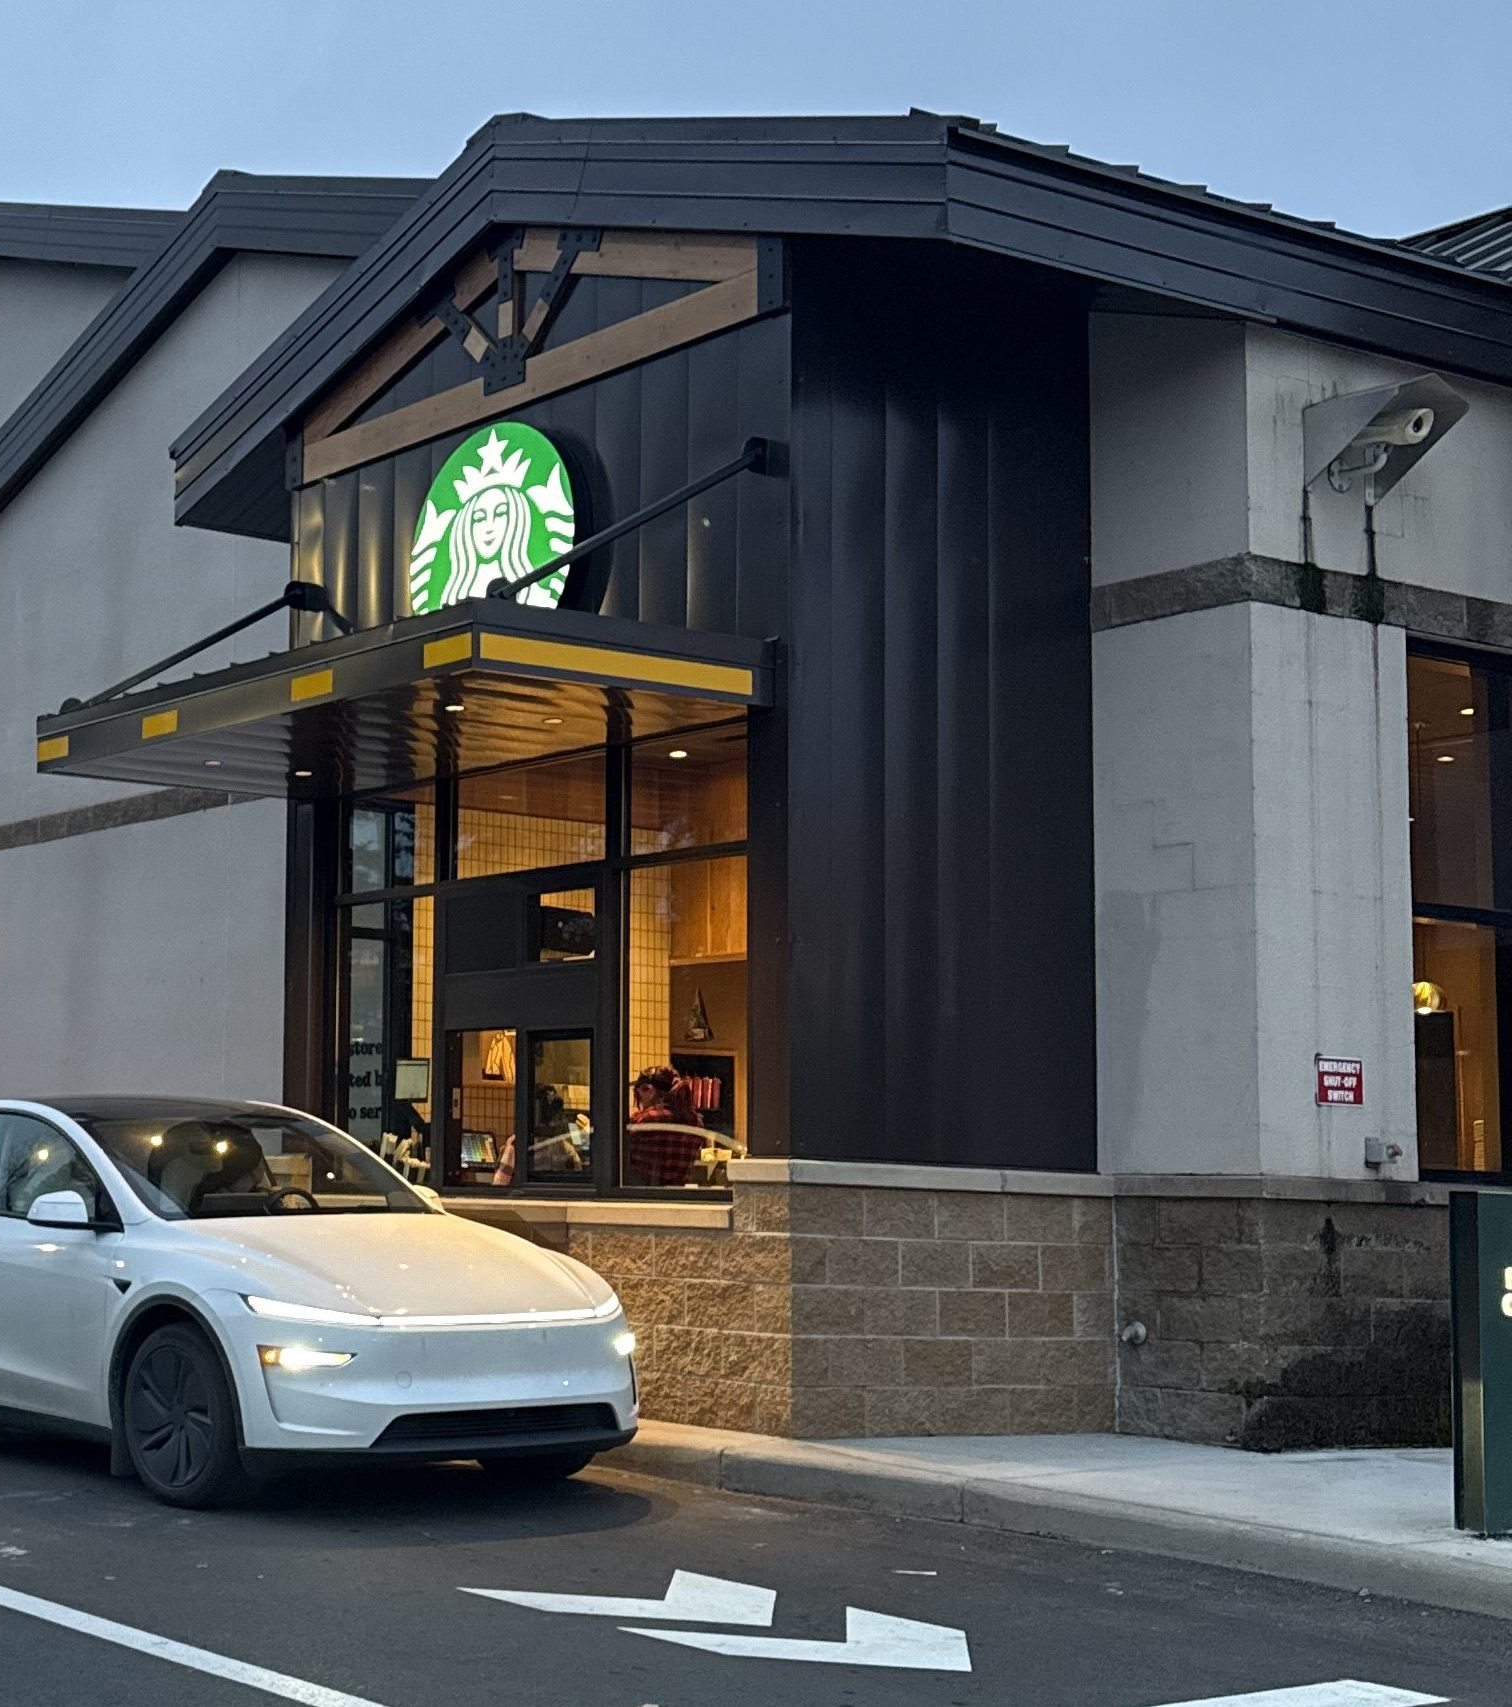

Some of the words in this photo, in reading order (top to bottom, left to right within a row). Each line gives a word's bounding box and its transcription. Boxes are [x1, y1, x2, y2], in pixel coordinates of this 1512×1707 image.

[1319, 1061, 1360, 1074] EMERGENCY
[1323, 1075, 1357, 1088] SHUT-OFF
[1327, 1090, 1354, 1102] SWITCH
